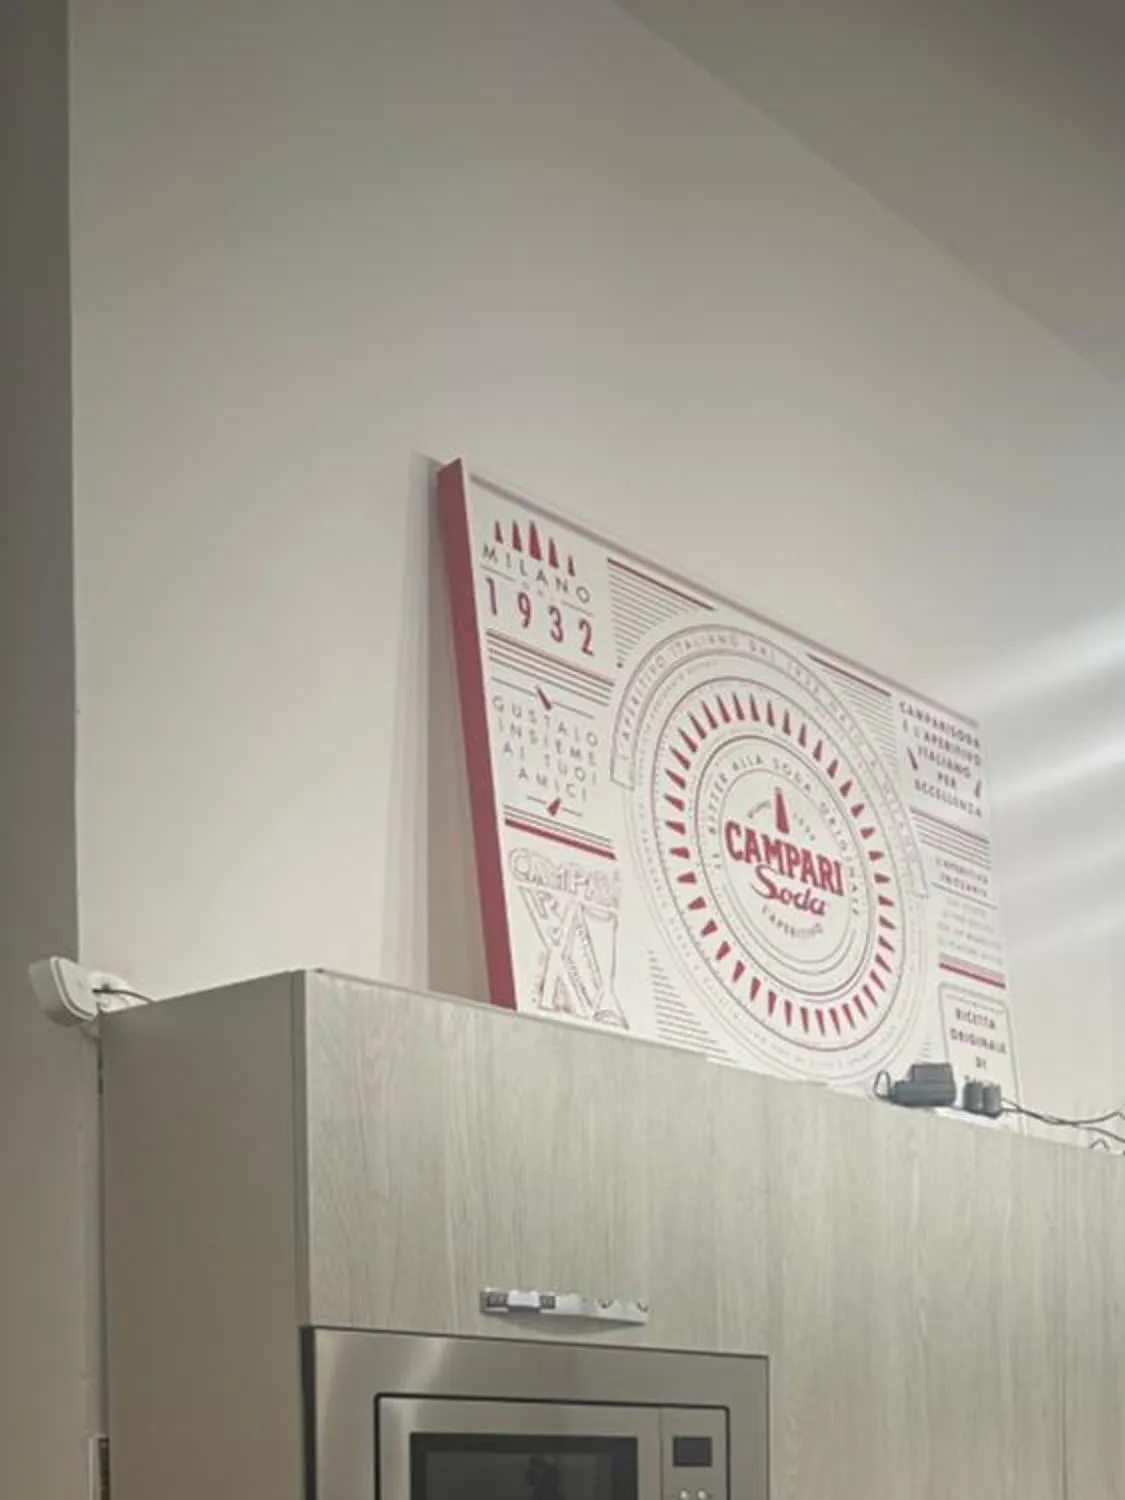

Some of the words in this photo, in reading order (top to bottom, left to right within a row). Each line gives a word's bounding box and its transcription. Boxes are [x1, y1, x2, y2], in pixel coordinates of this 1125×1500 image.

[483, 544, 591, 604] MILANO
[486, 576, 594, 656] 1932
[492, 696, 598, 747] GUSTALO
[498, 716, 597, 767] INSIEME
[503, 741, 525, 761] AI
[544, 754, 597, 786] TUOI
[518, 767, 587, 802] AMICI
[729, 753, 763, 773] ALLA
[725, 820, 844, 897] CAMPARI
[750, 863, 826, 916] Soda
